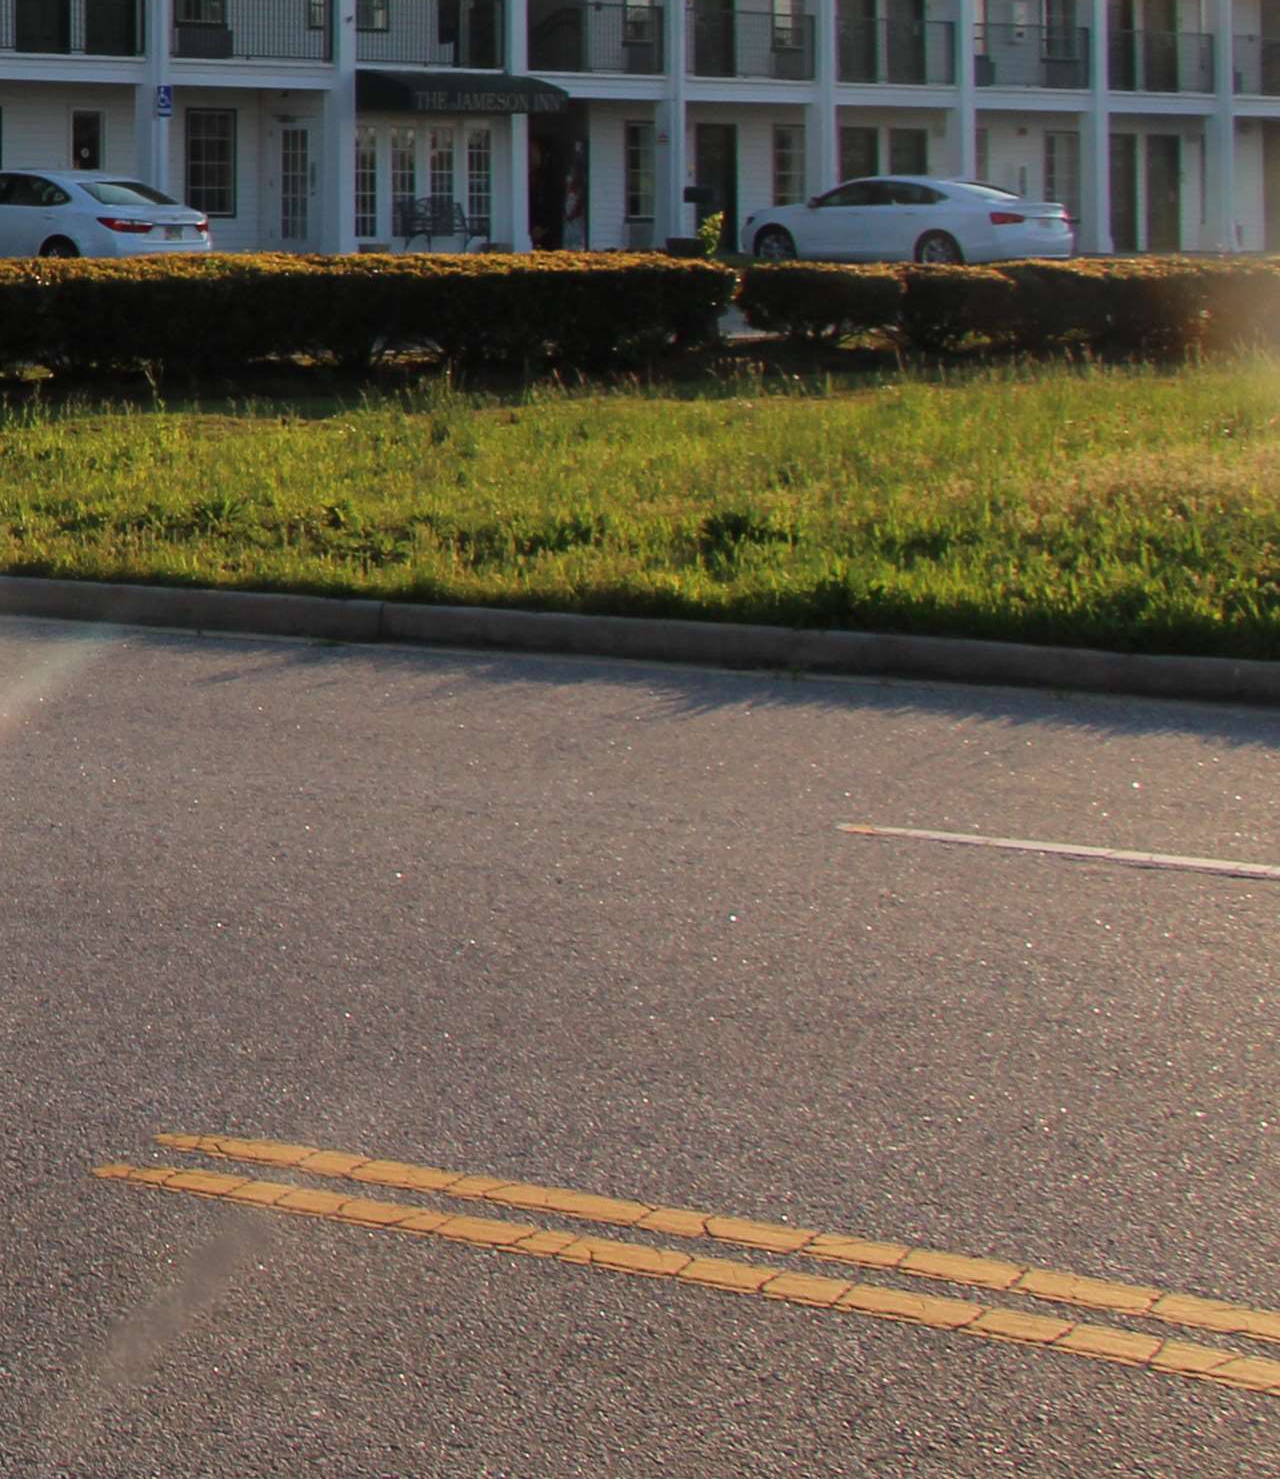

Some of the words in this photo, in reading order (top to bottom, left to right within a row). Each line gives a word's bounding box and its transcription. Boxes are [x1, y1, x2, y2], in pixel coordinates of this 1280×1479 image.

[415, 91, 448, 110] THE
[452, 92, 529, 112] JAMESON
[532, 93, 561, 113] INN
